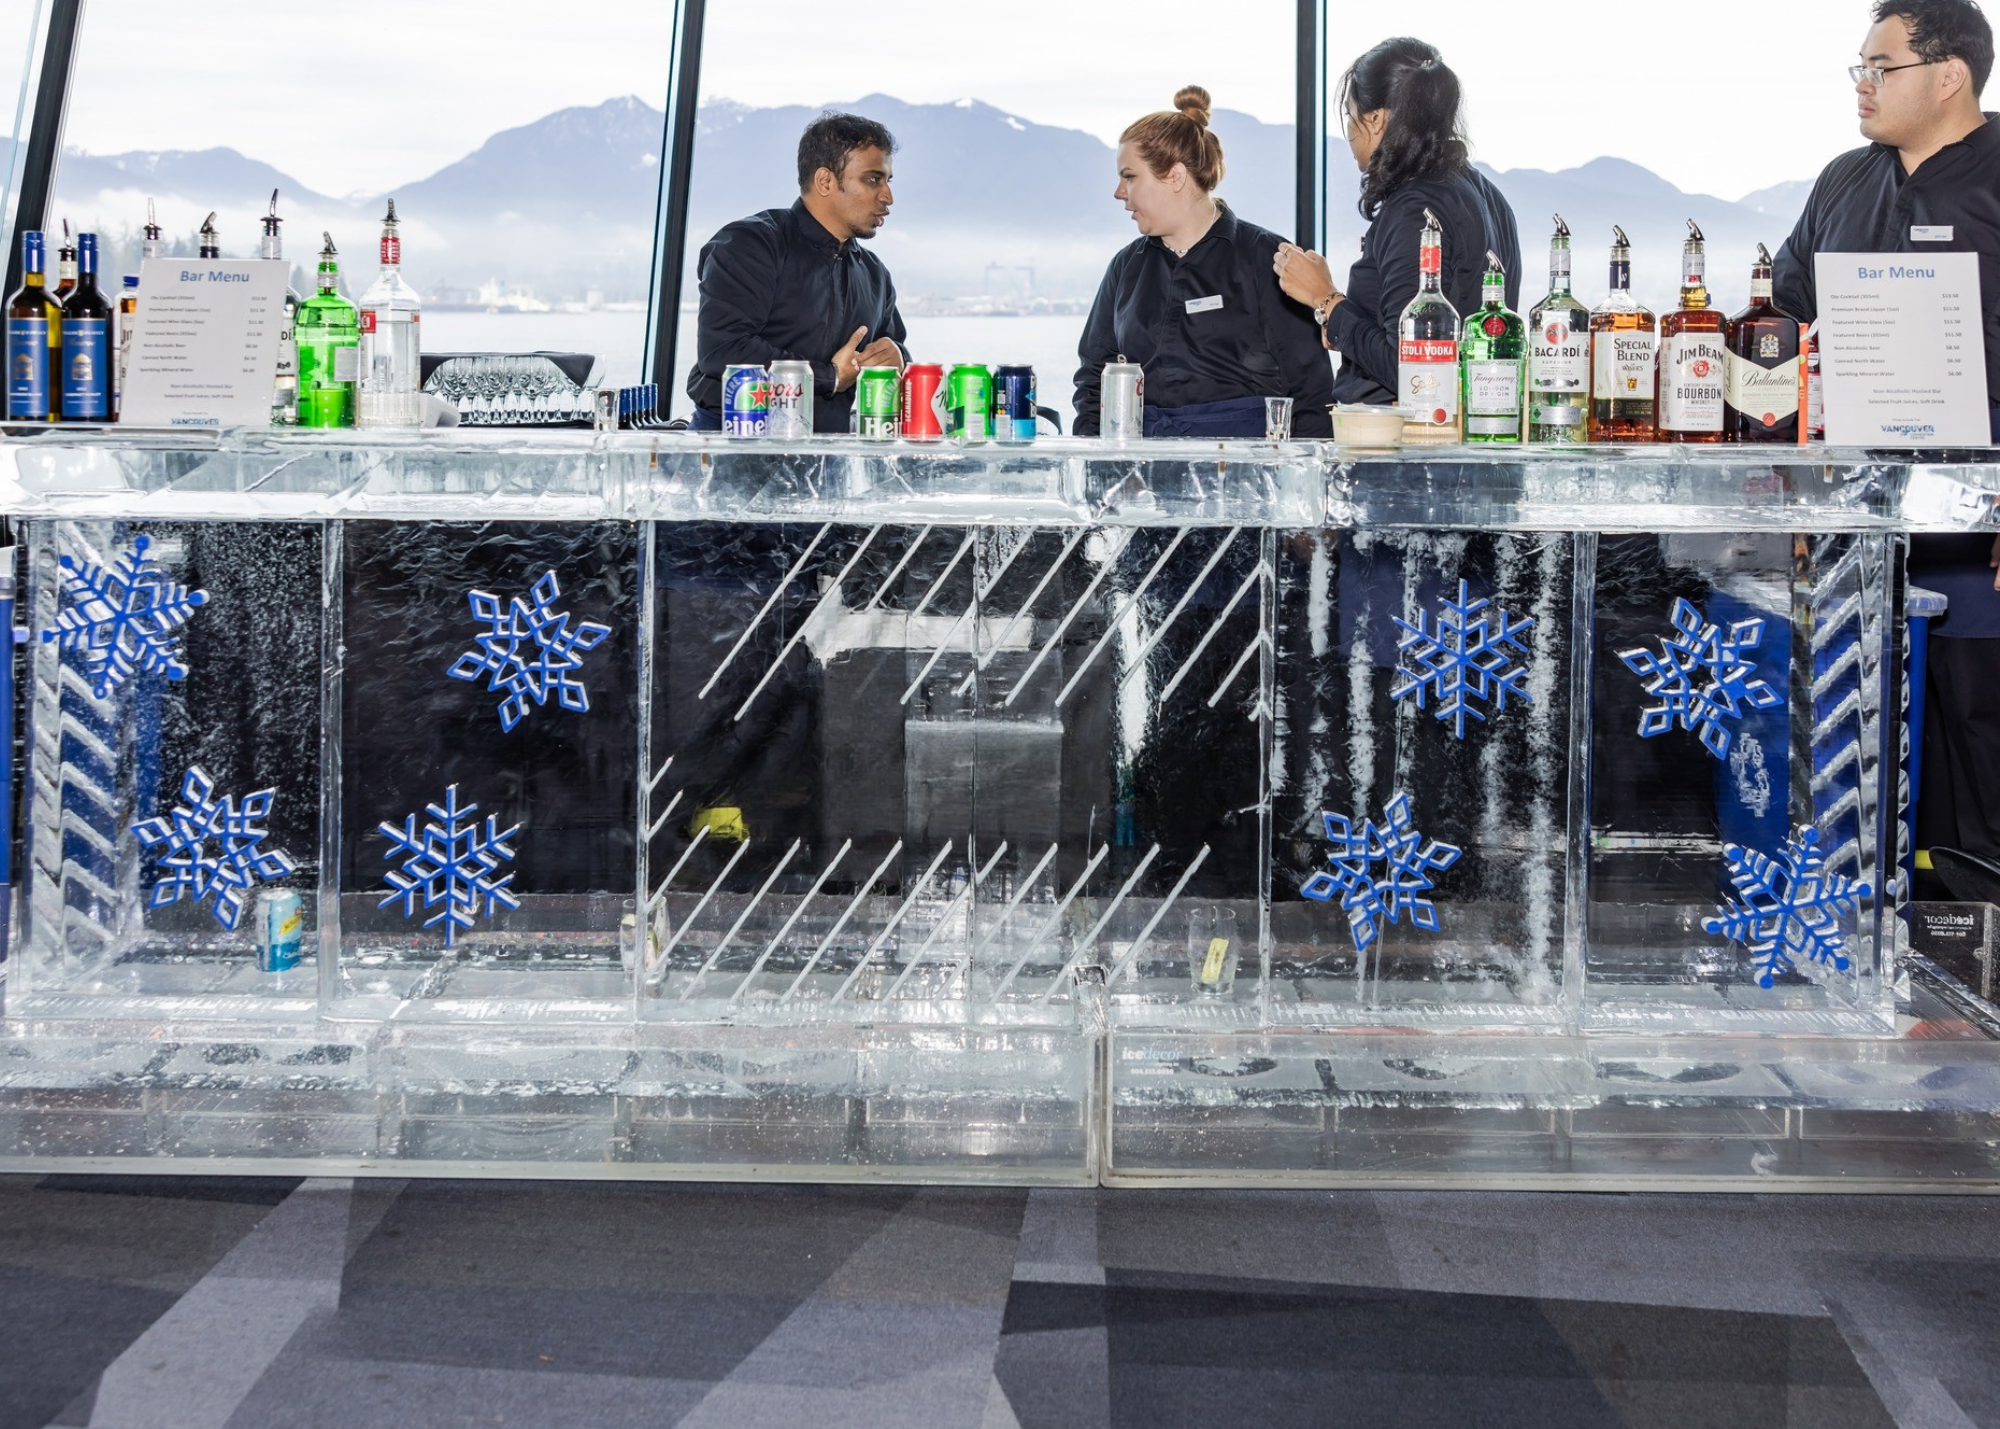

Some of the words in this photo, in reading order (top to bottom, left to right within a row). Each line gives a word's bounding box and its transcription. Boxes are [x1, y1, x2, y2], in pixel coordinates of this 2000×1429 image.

[180, 270, 204, 282] Bar
[208, 271, 250, 282] Menu
[1858, 266, 1884, 279] Bar
[1889, 266, 1935, 278] Menu
[1614, 338, 1652, 350] SPECIAL
[1401, 345, 1422, 355] STOLI
[1424, 346, 1453, 356] VODKA
[1535, 345, 1580, 357] BACARDÍ
[1617, 350, 1650, 361] BLEND
[1676, 348, 1696, 364] JIM
[1698, 344, 1724, 364] BEAM
[1677, 388, 1722, 399] BOURBON
[1881, 424, 1935, 433] VANCOUVER
[1122, 1046, 1184, 1060] icedecor
